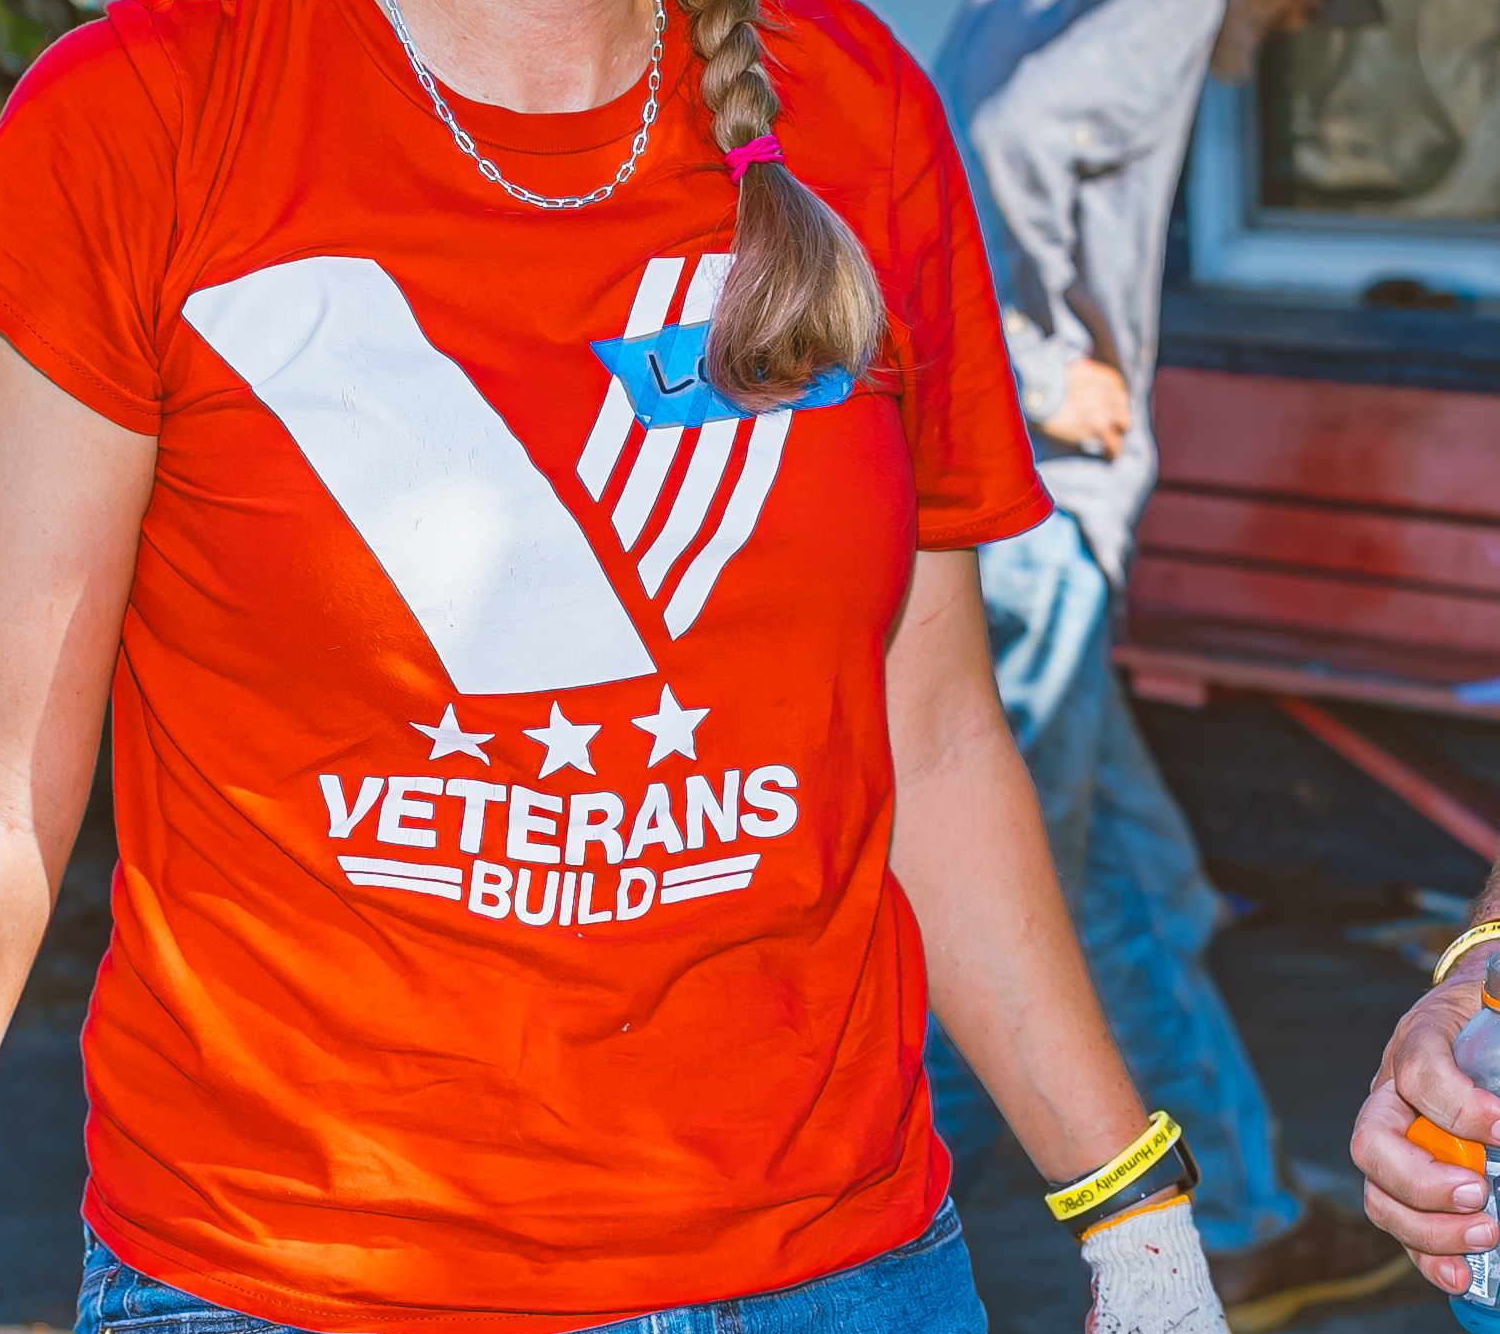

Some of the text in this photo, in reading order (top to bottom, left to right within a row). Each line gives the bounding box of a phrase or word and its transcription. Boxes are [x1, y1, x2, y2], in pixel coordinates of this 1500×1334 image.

[318, 764, 800, 867] VETERANS
[467, 859, 657, 927] BUILD
[1059, 1130, 1168, 1213] for Humanity GPBC
